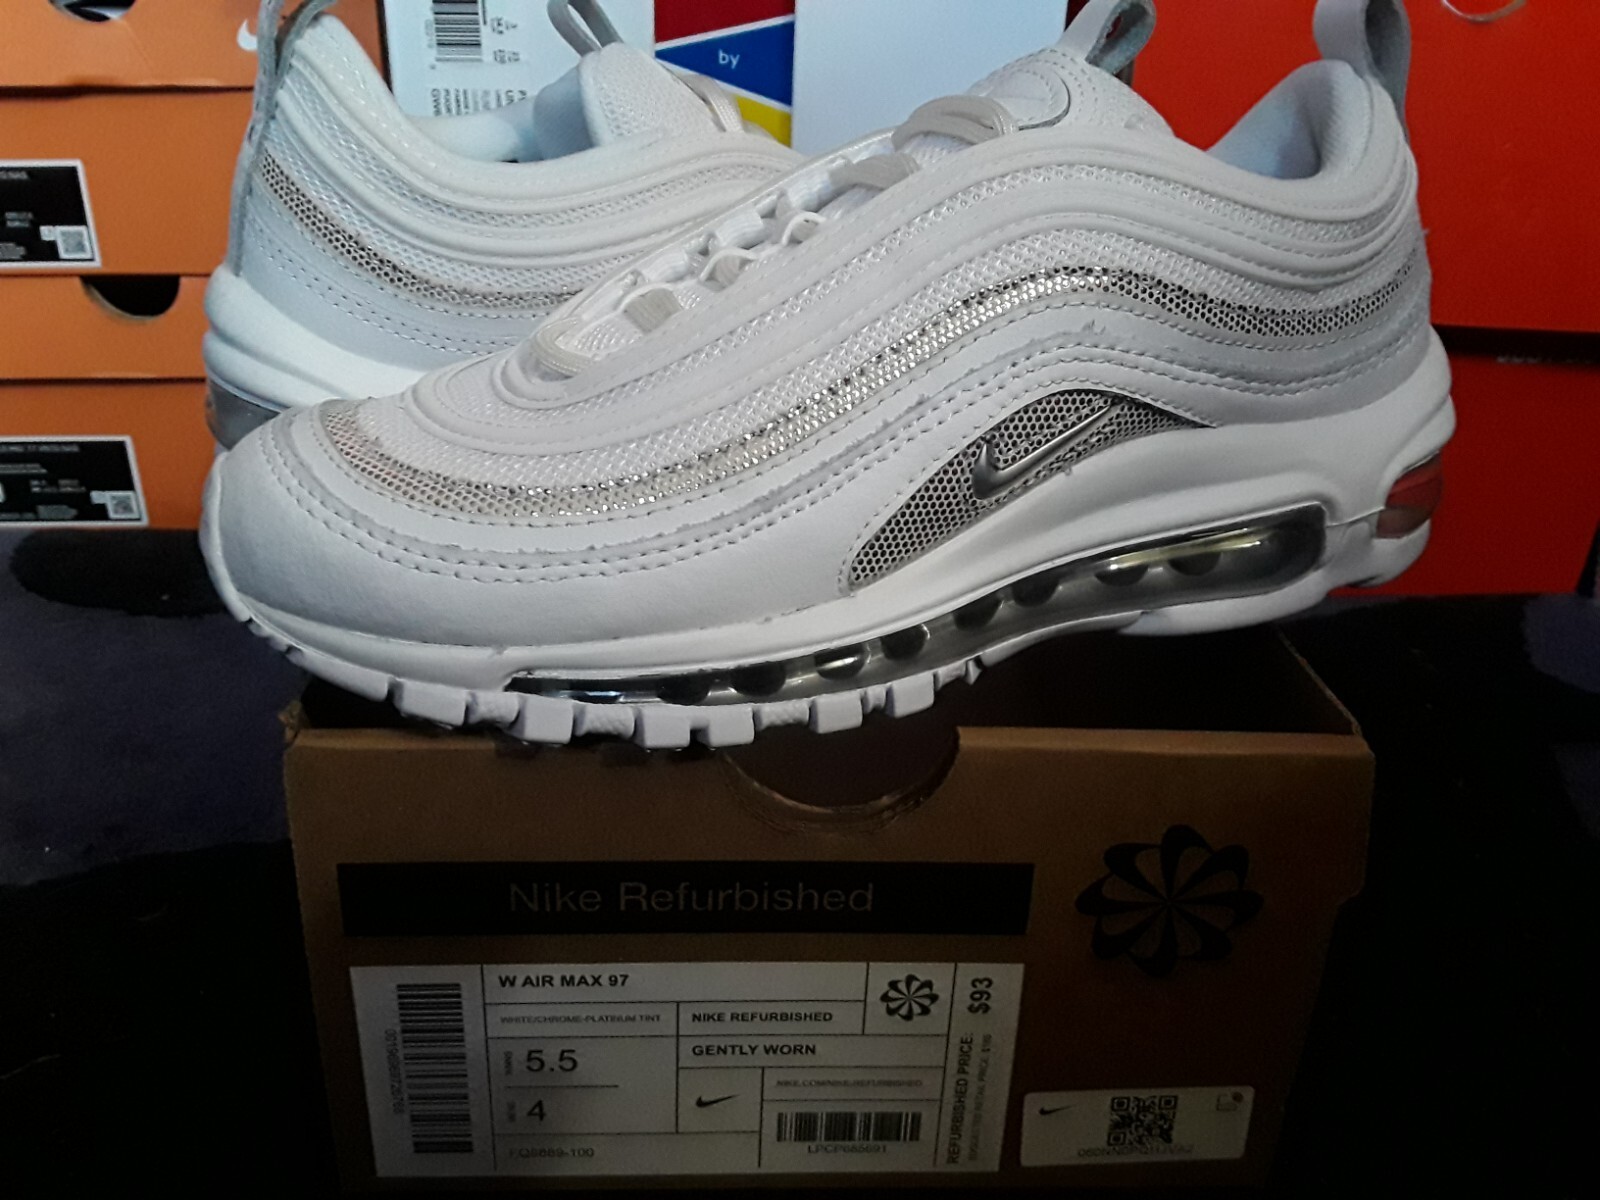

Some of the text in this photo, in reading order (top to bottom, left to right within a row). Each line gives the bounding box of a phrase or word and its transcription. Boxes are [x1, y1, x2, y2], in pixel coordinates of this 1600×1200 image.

[718, 48, 740, 69] by
[509, 881, 874, 912] Nike Refurbished
[498, 974, 630, 988] W AIR MAX 97
[967, 977, 994, 1015] $93
[639, 1014, 662, 1023] TINT
[692, 1012, 833, 1023] NIKE REFURBISHED
[692, 1044, 817, 1056] GENTLY WORN
[525, 1049, 578, 1073] 5.5
[947, 1032, 974, 1165] REFURBISHED PRICE:
[526, 1100, 547, 1122] 4
